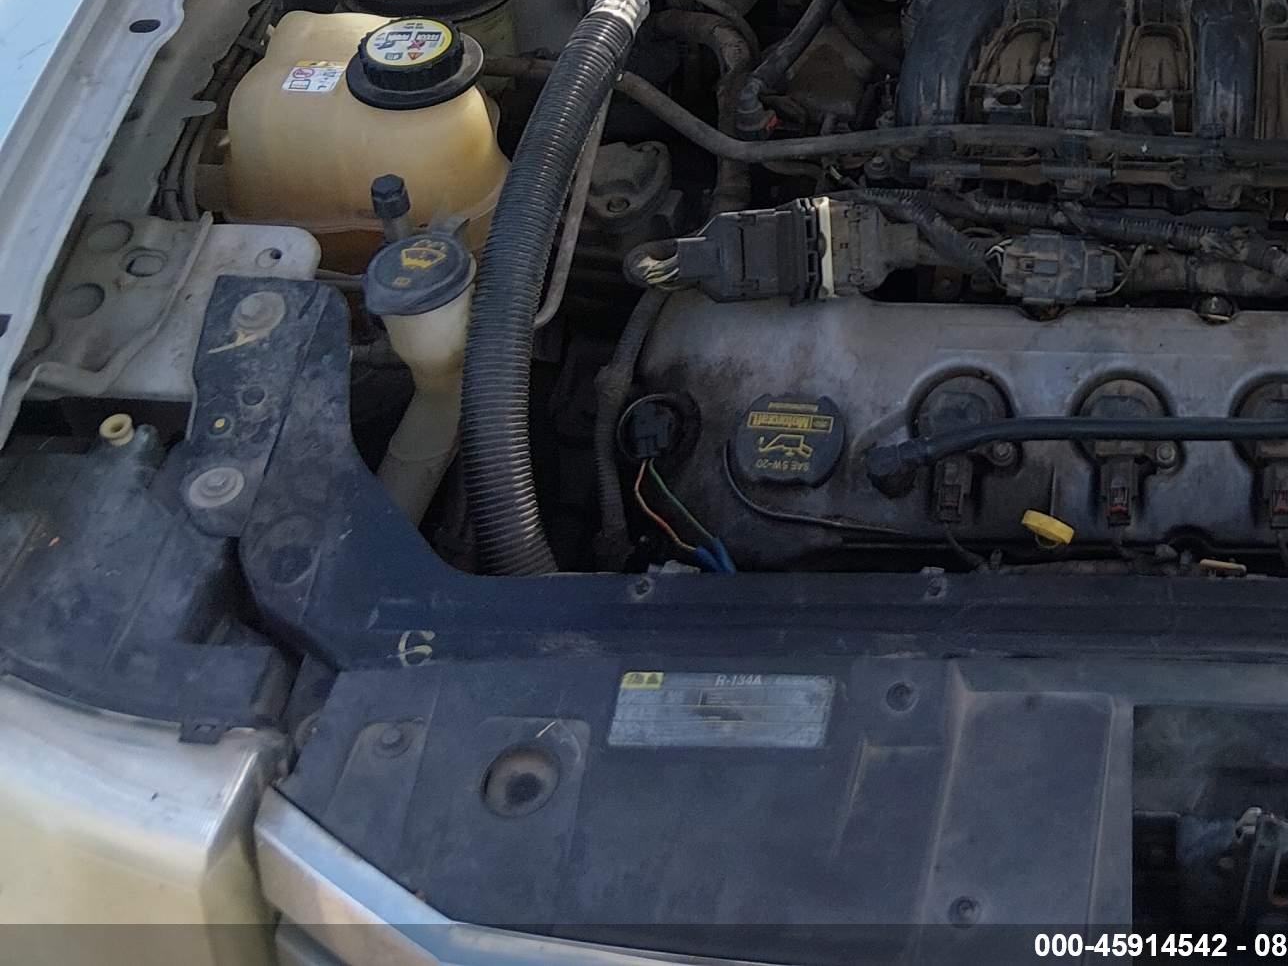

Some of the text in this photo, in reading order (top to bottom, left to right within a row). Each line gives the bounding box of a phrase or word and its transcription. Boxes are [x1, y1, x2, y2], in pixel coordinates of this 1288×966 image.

[752, 413, 810, 429] Motorcraft
[755, 458, 810, 472] SAE 5W-20
[714, 673, 763, 687] R-134A
